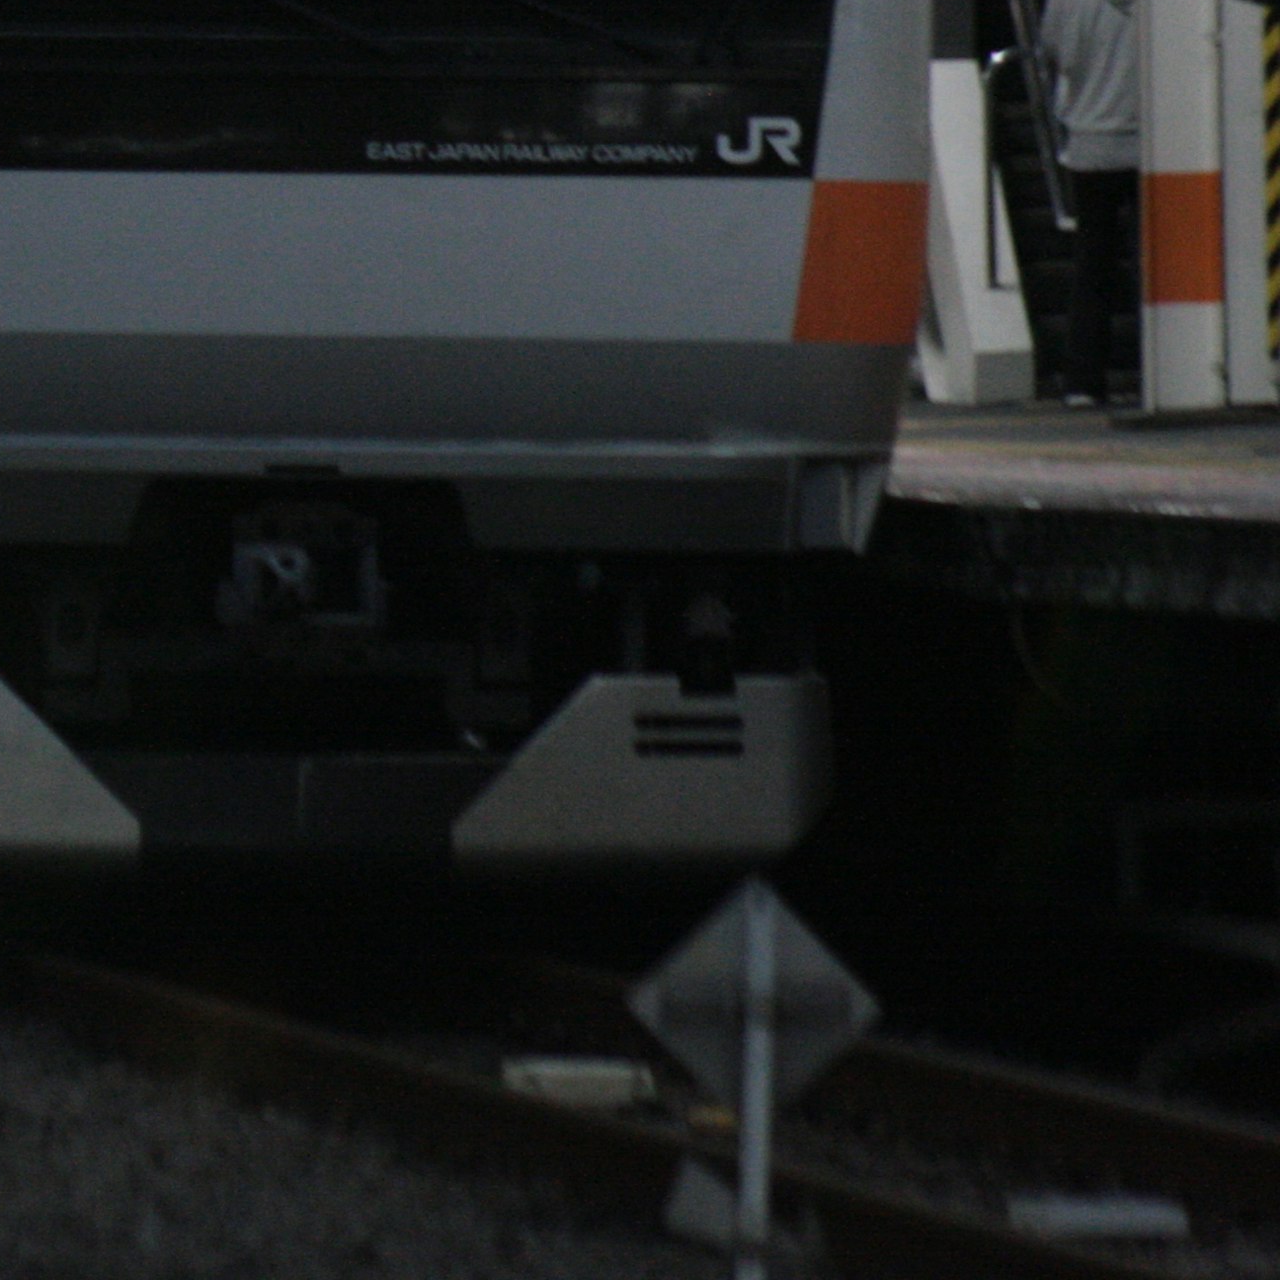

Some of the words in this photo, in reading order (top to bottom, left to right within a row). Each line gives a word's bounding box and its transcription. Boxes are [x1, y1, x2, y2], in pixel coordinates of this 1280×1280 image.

[365, 142, 426, 161] EAST
[428, 142, 500, 162] JAPAN
[502, 143, 589, 163] RAILWAY
[592, 143, 698, 164] COMPANY
[716, 116, 801, 166] JR
